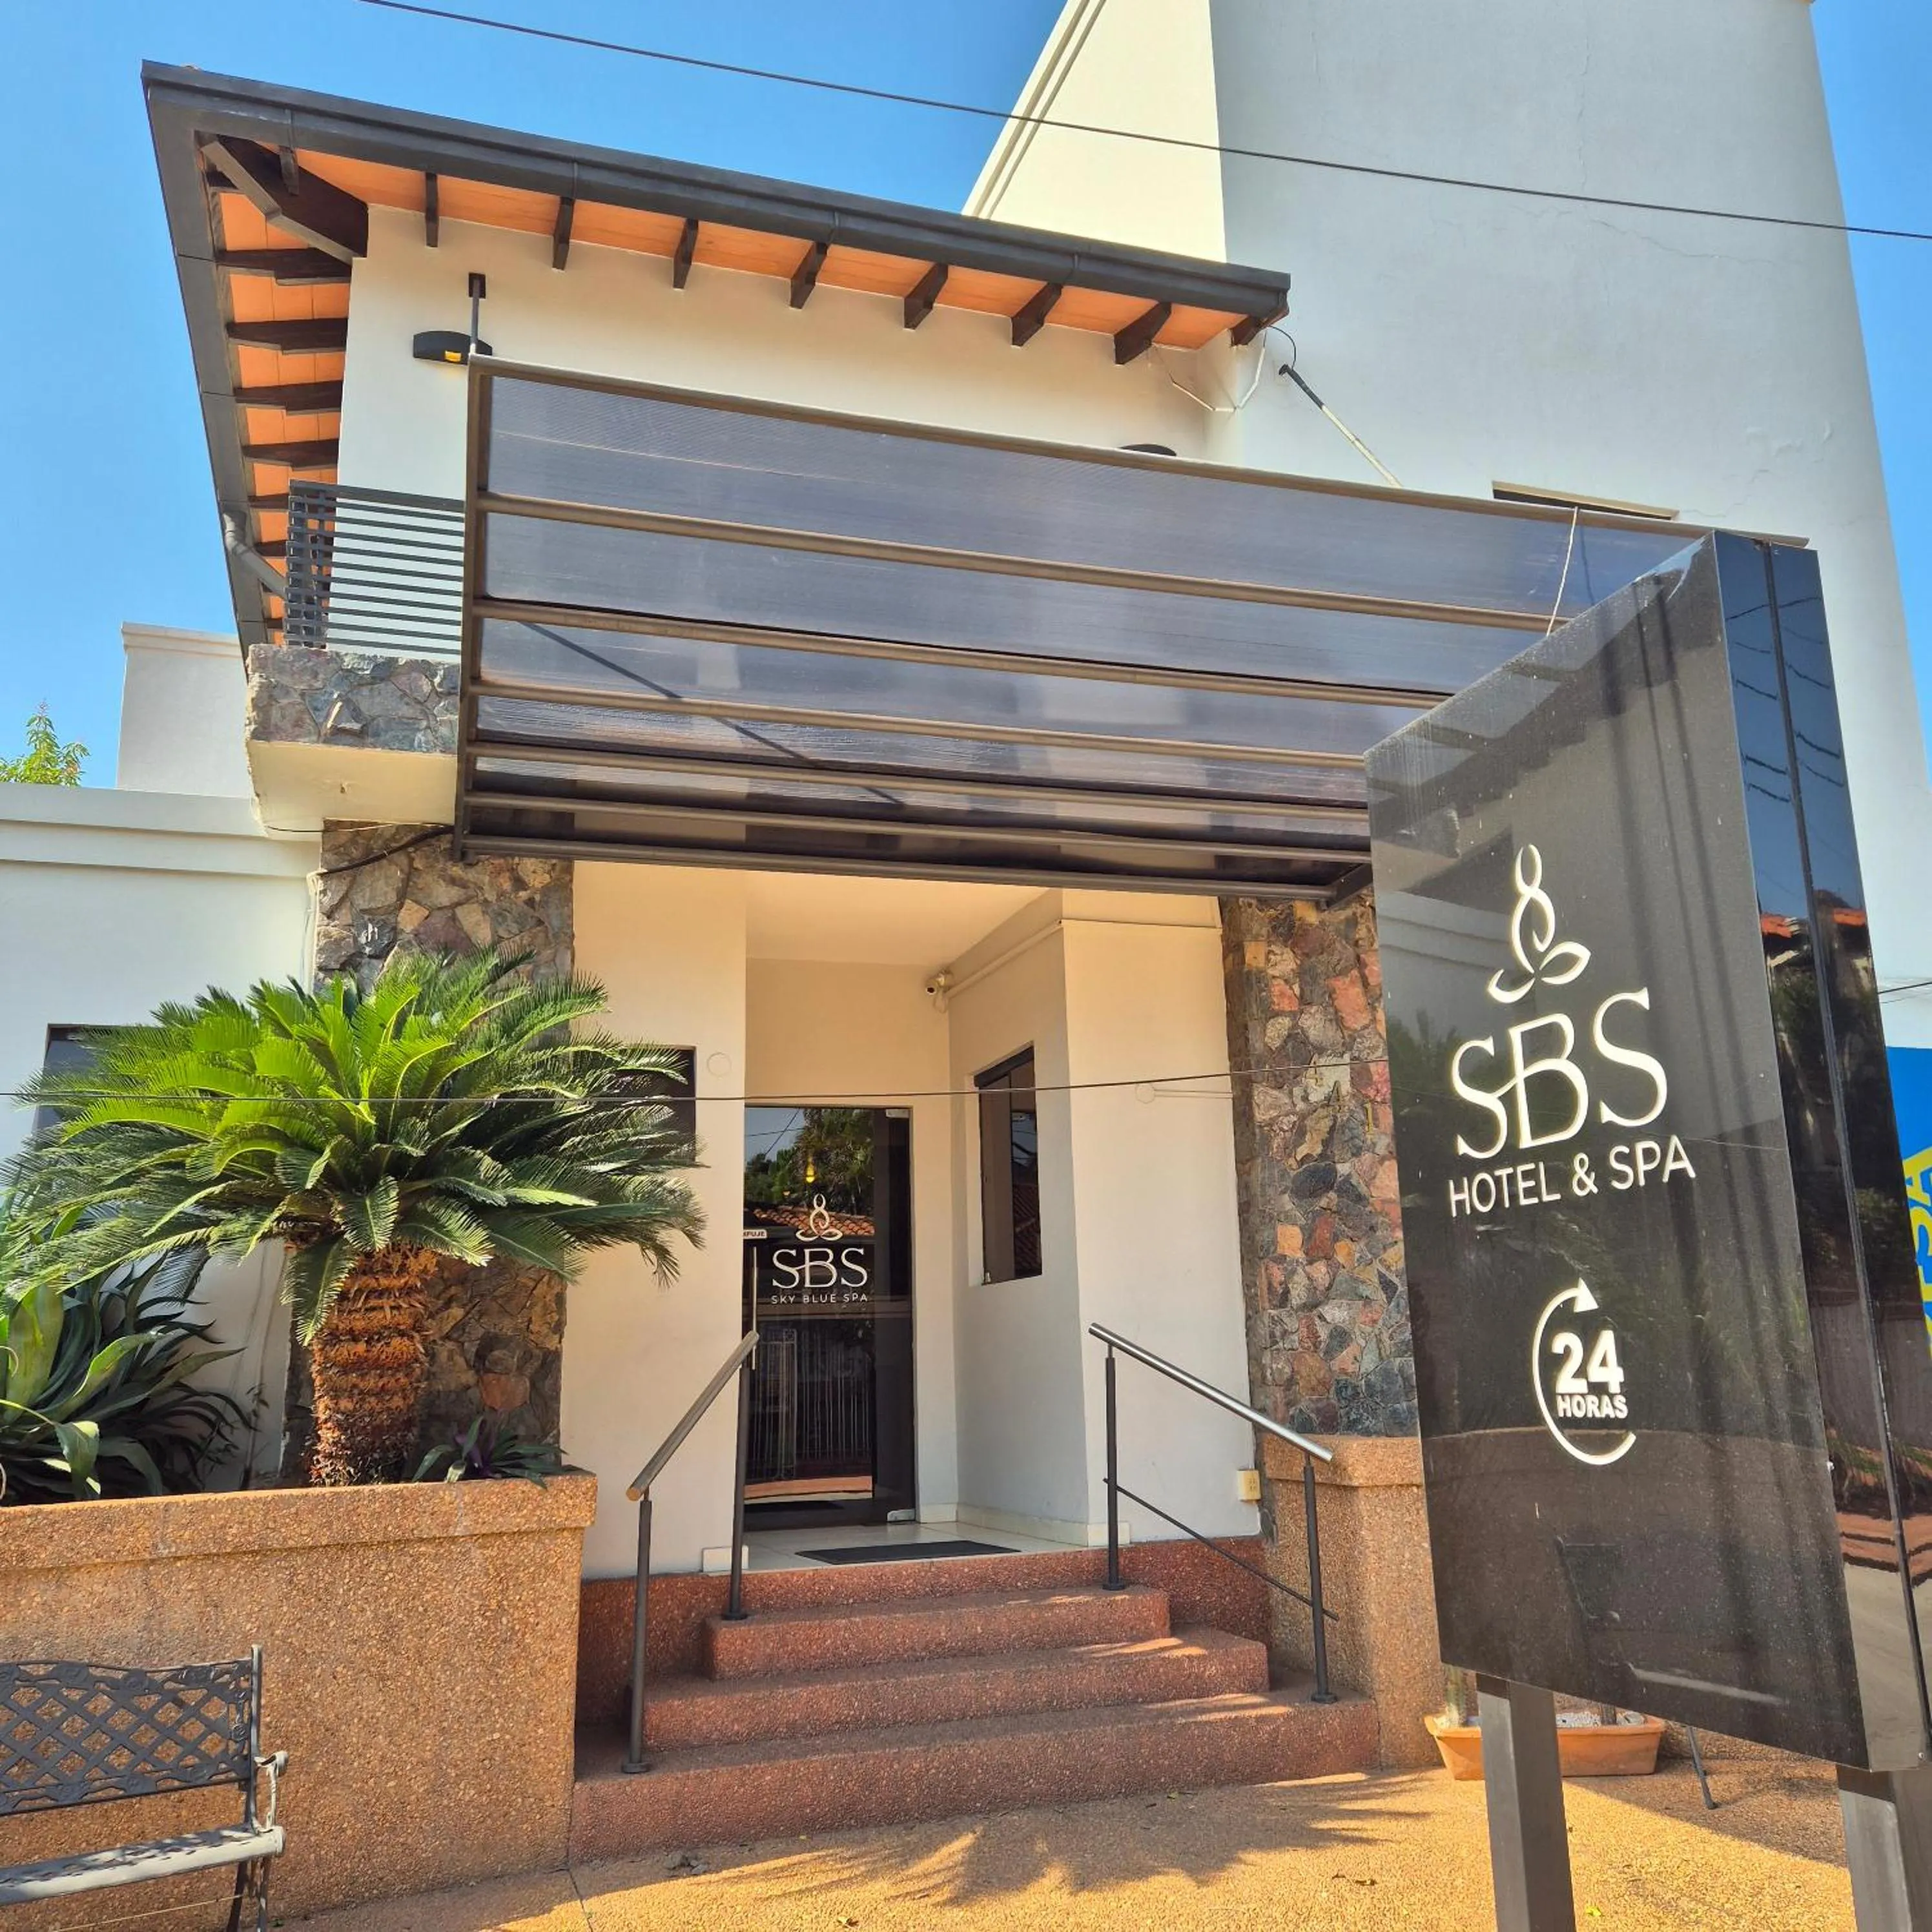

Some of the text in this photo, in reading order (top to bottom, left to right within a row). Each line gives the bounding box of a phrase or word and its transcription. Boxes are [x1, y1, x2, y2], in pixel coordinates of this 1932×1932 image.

[1452, 987, 1667, 1158] SBS
[1449, 1134, 1696, 1217] HOTEL & SPA
[772, 1248, 868, 1288] SBS
[771, 1292, 868, 1304] SKY BLUE SPA
[1551, 1330, 1625, 1394] 24
[1556, 1394, 1629, 1419] HORAS
